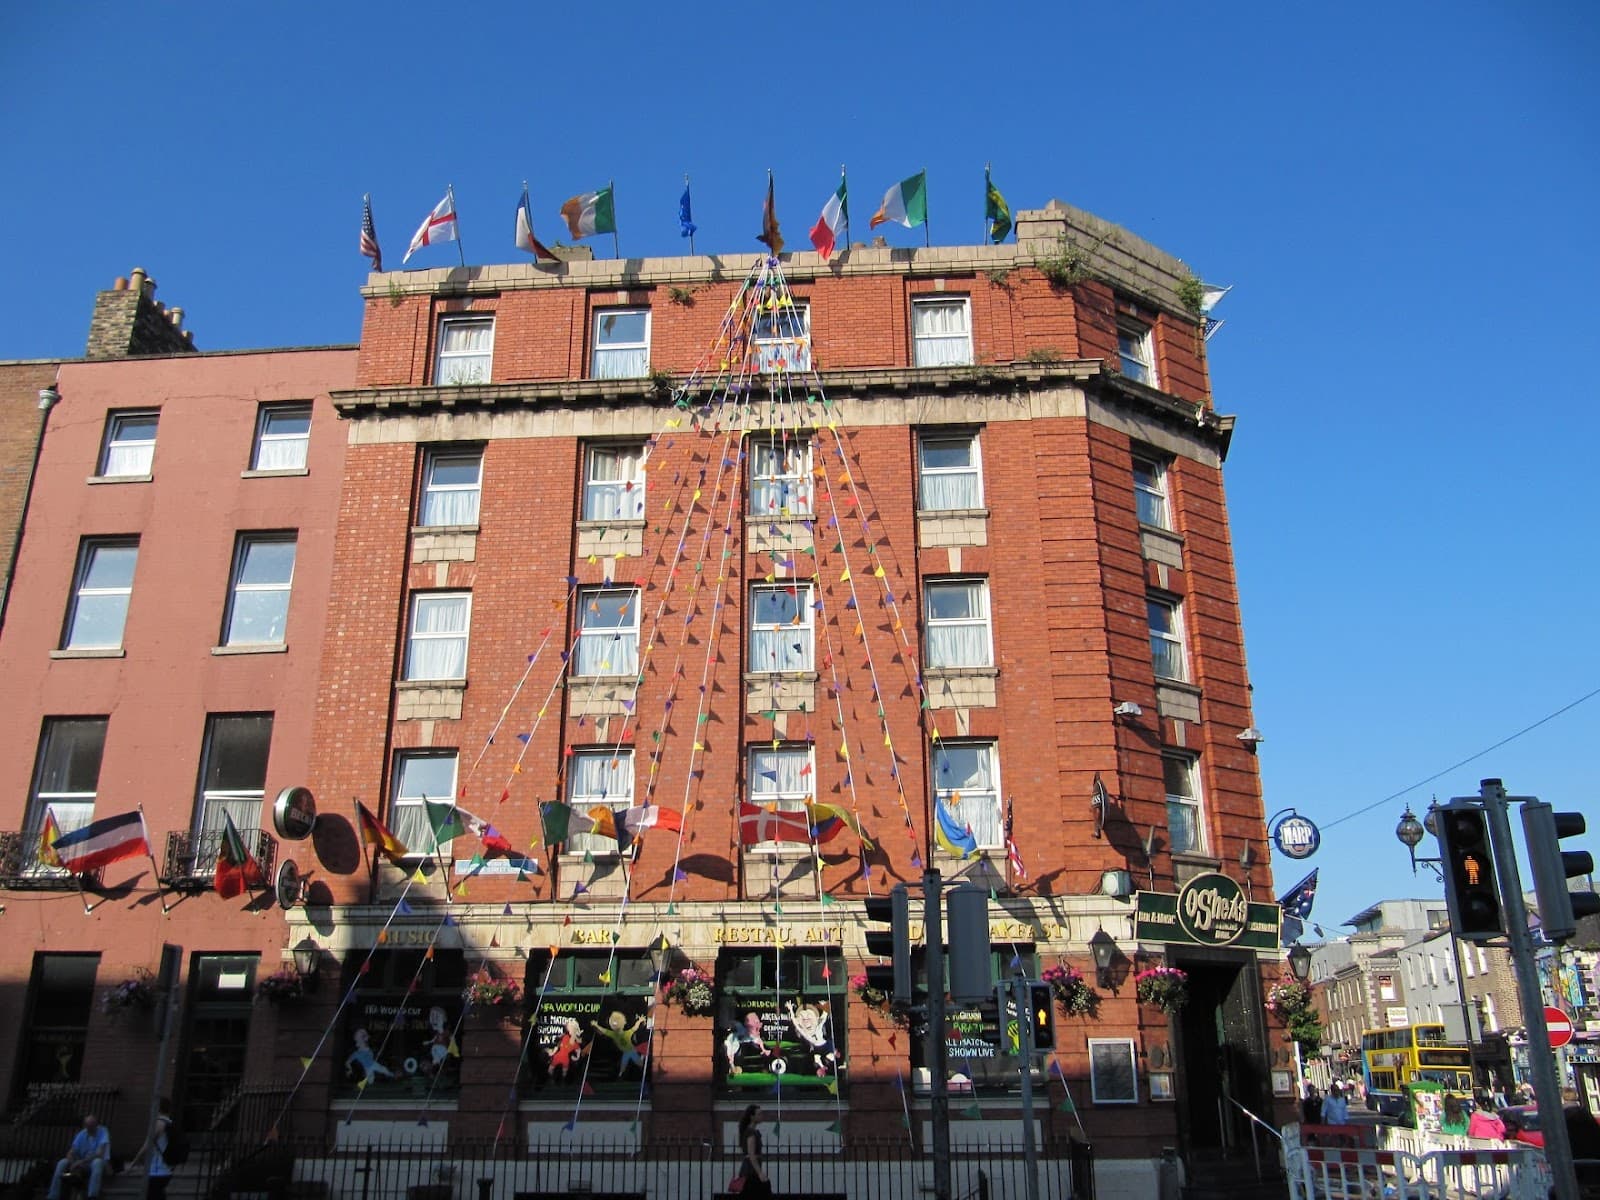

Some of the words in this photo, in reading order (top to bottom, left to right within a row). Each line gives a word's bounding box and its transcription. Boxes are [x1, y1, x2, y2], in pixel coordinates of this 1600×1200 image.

[573, 929, 610, 943] BAR
[584, 1003, 601, 1013] CUP
[949, 1047, 977, 1057] SHOWN
[977, 1047, 995, 1057] LIVE
